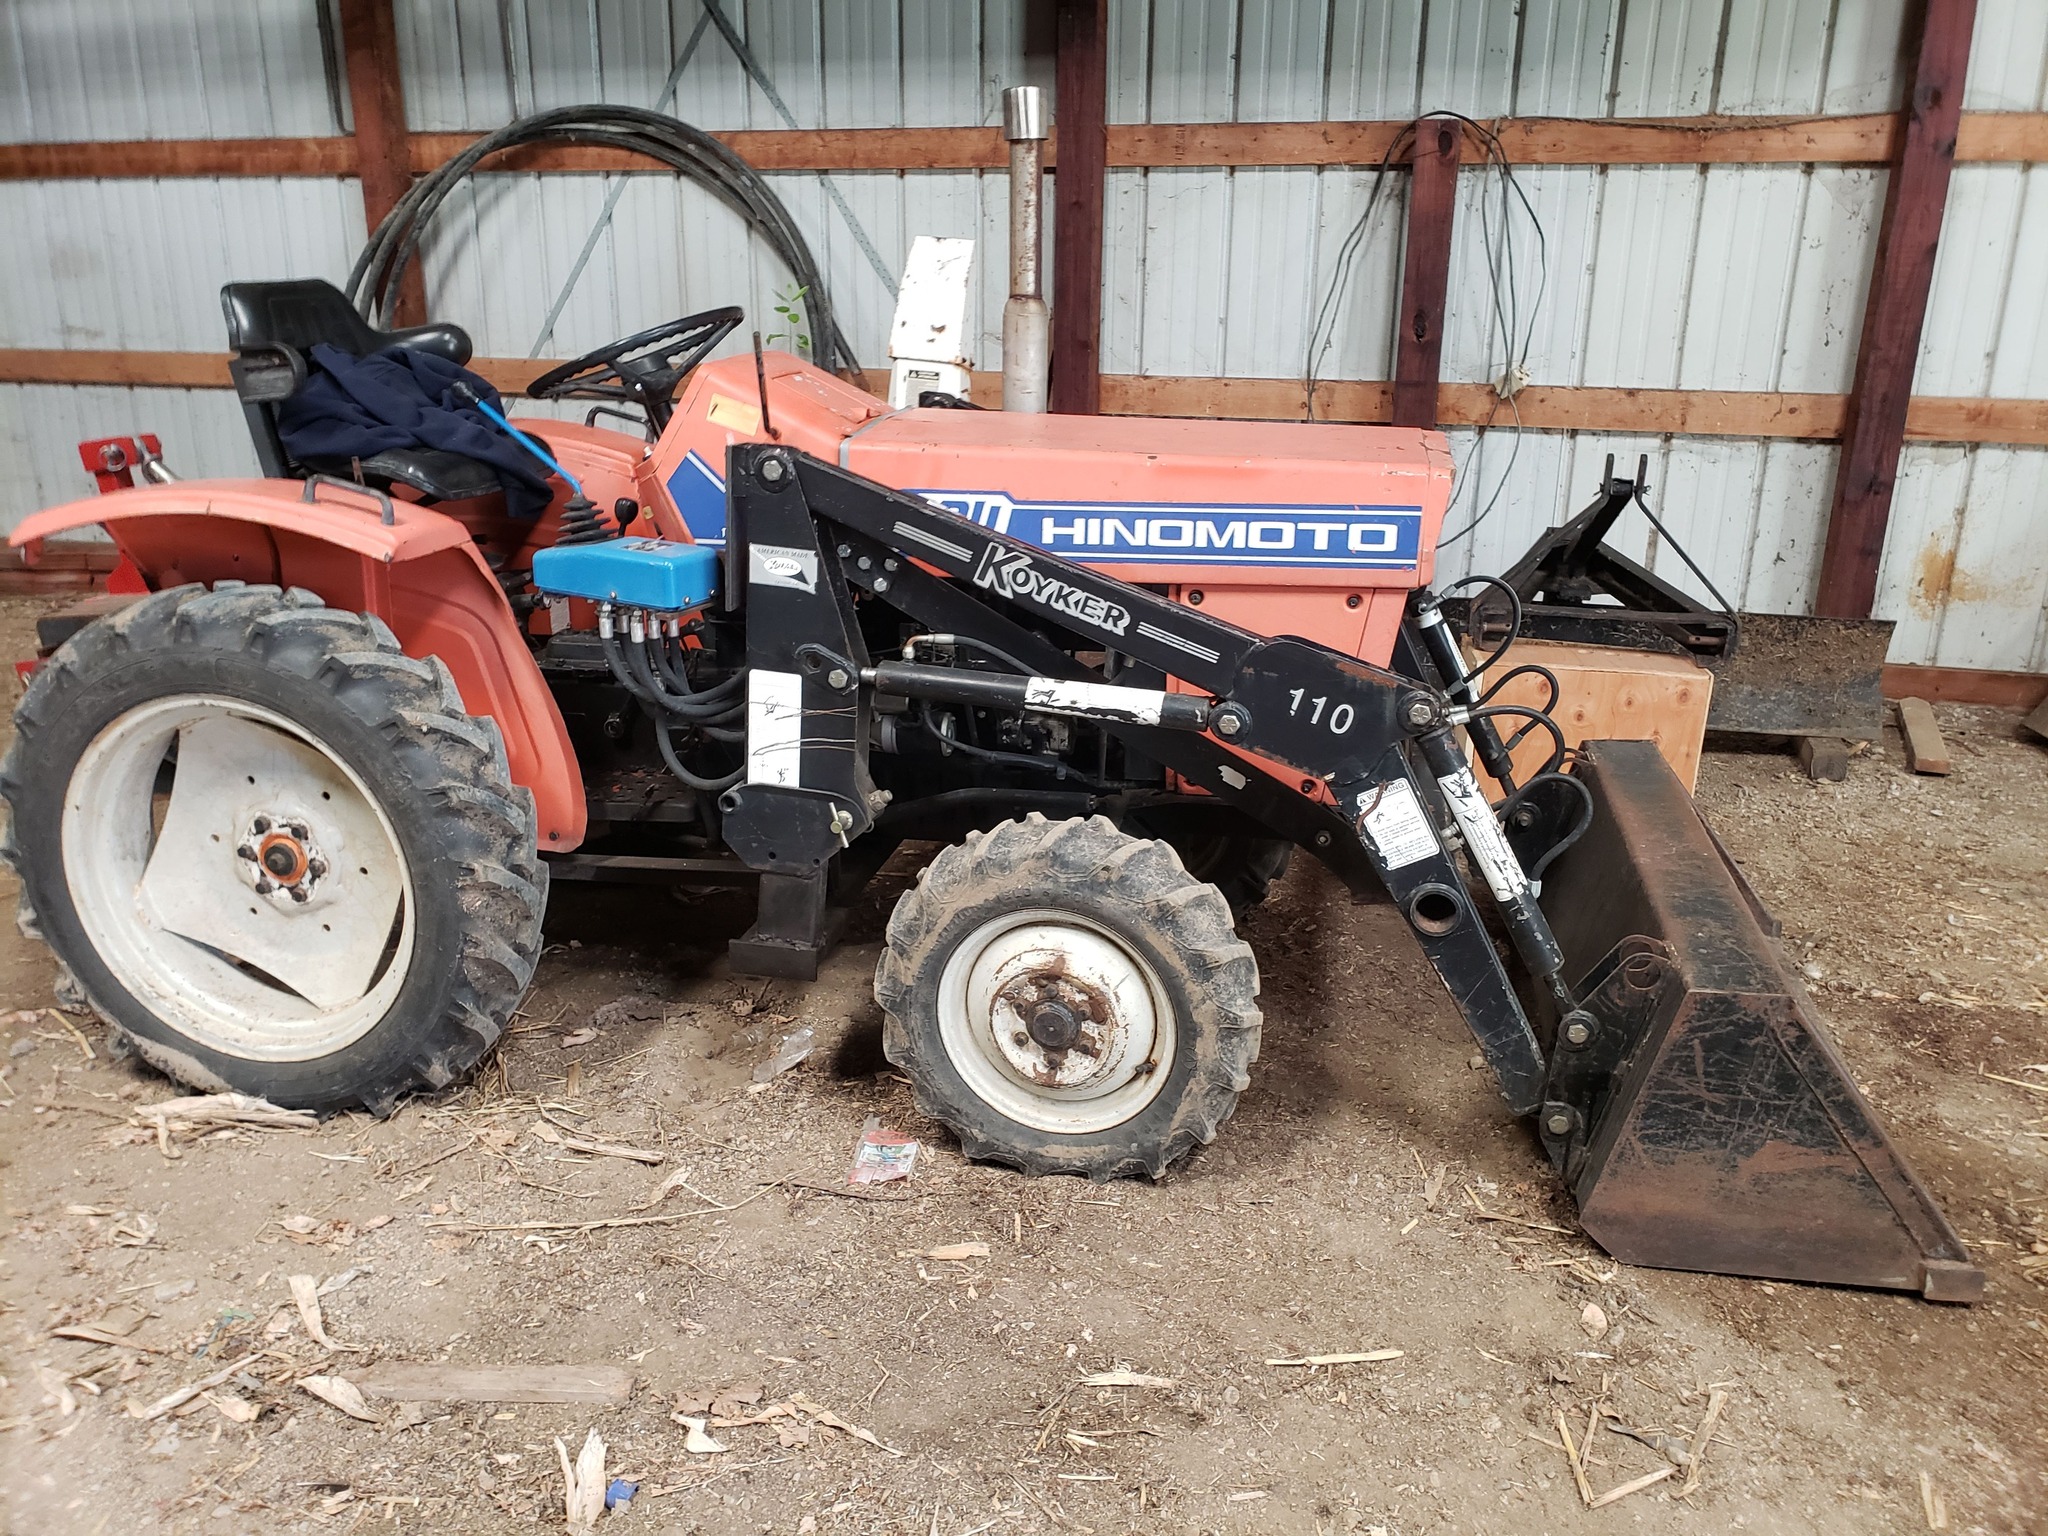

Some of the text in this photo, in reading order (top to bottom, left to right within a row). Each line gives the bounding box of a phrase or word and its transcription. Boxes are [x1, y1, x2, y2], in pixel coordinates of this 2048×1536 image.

[1041, 517, 1399, 551] HINOMOTO
[973, 542, 1131, 636] KOYKER
[1289, 688, 1354, 735] 110
